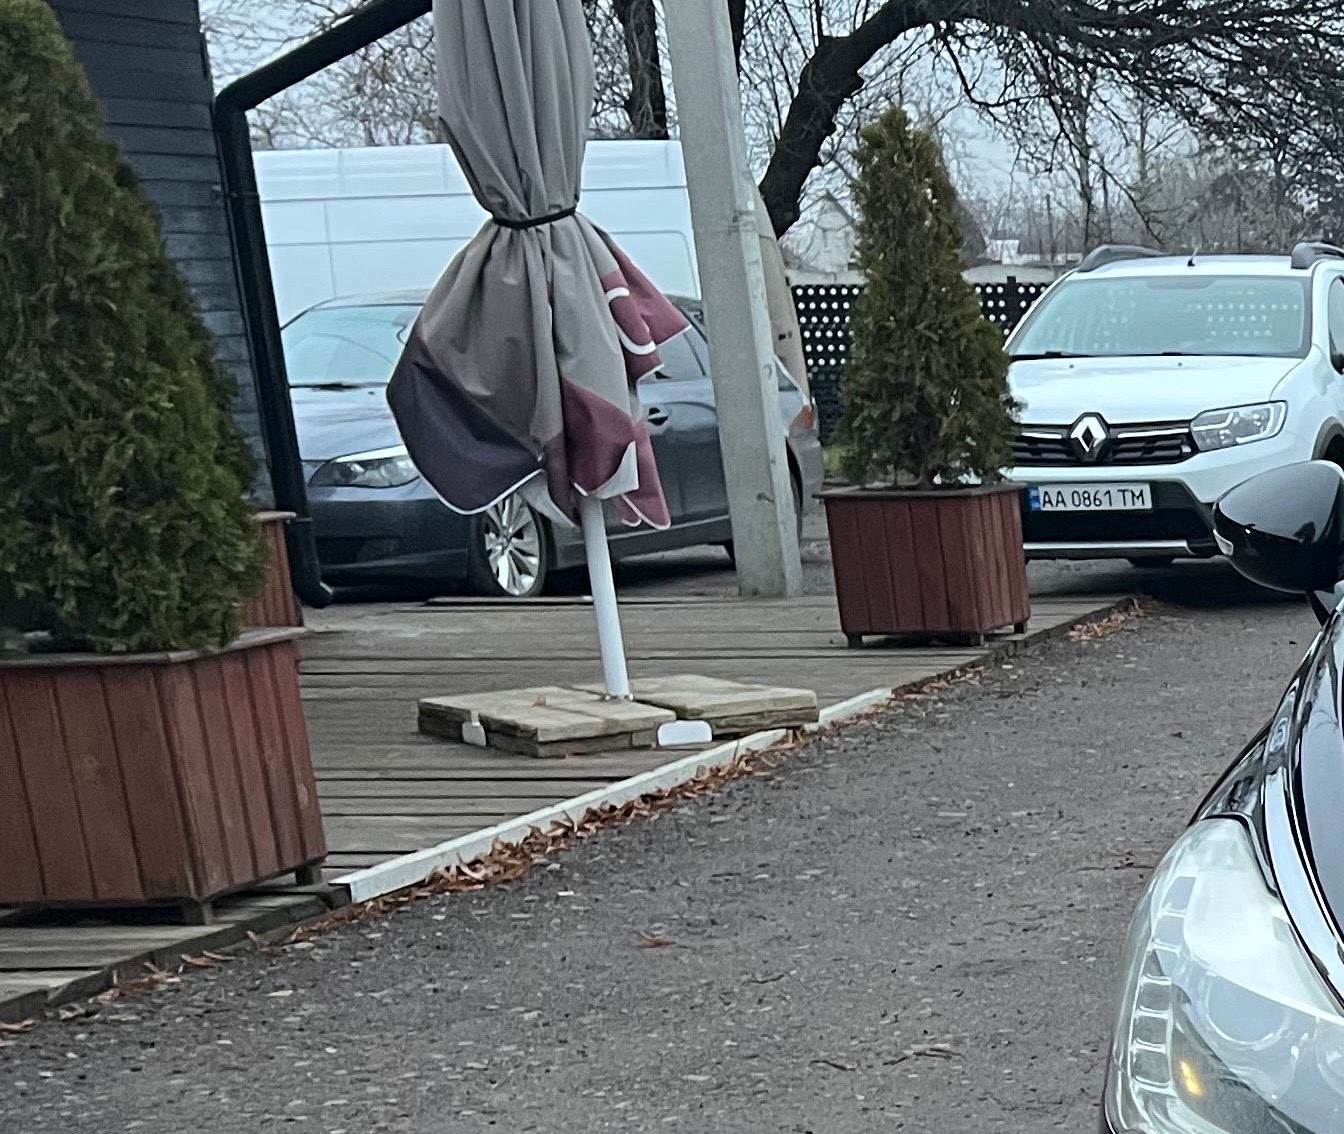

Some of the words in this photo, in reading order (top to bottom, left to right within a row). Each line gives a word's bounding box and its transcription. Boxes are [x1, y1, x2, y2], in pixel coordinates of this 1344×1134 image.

[1042, 491, 1067, 508] AA
[1071, 490, 1113, 508] 0861
[1117, 489, 1145, 507] TM
